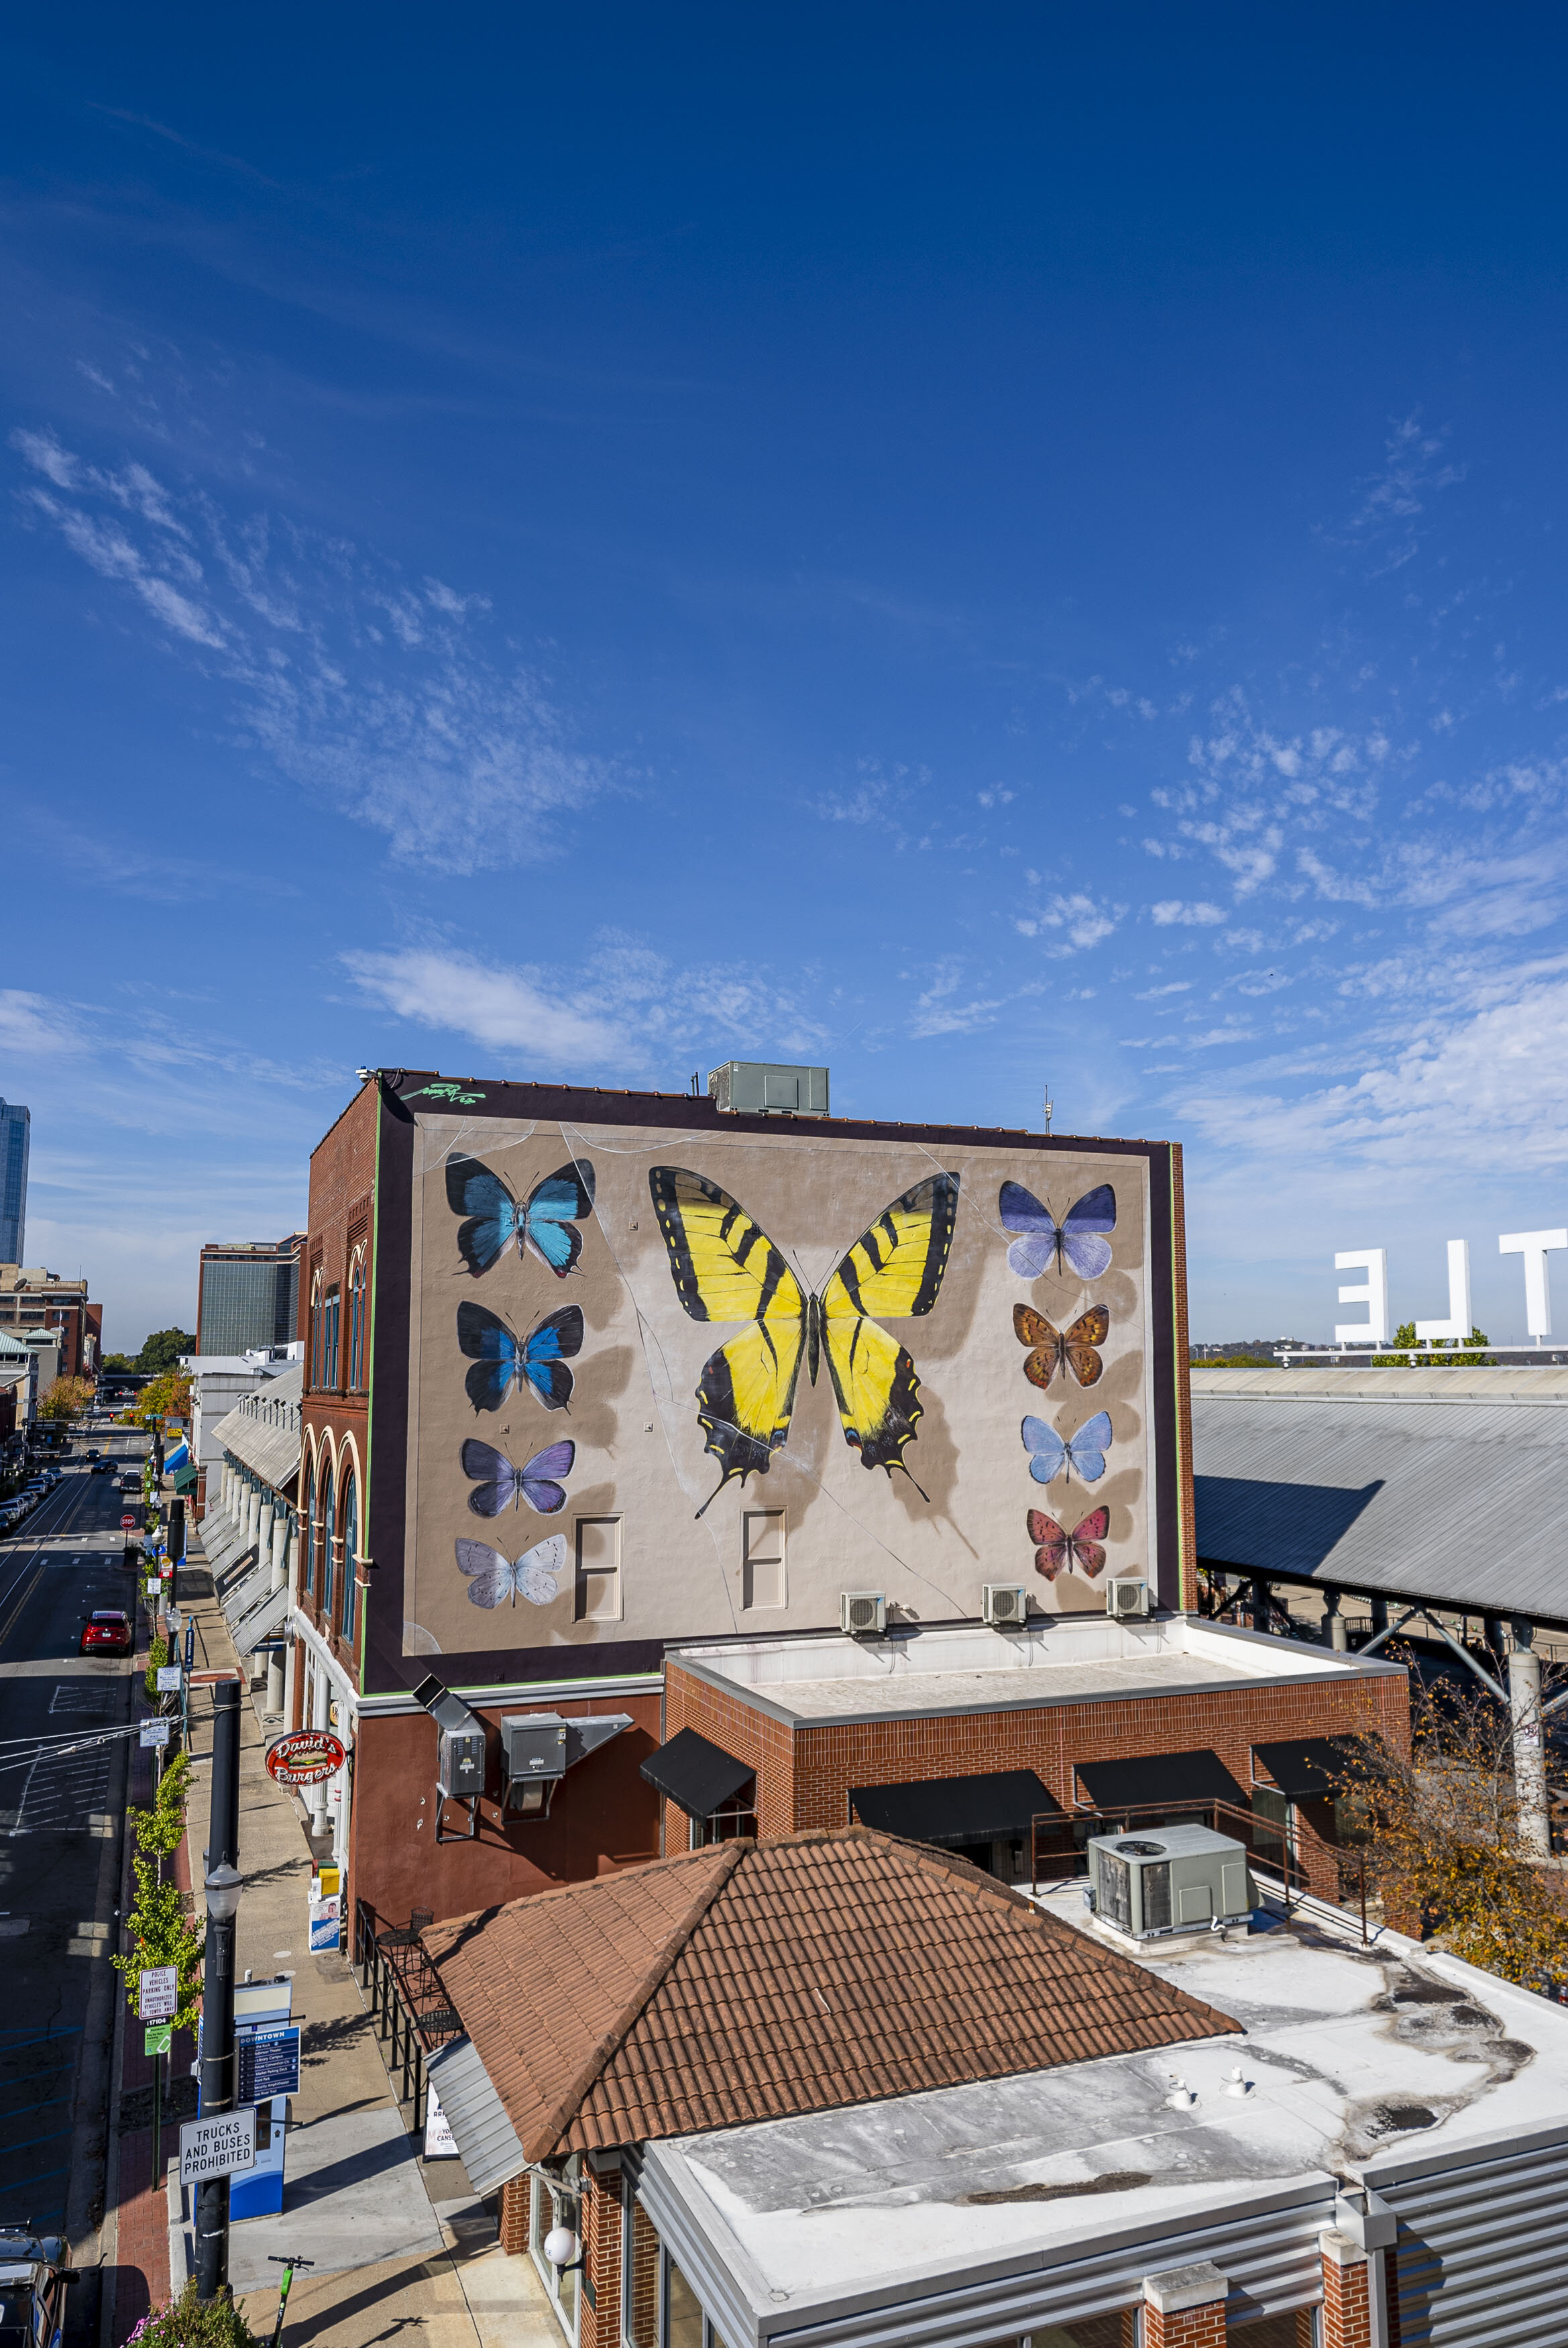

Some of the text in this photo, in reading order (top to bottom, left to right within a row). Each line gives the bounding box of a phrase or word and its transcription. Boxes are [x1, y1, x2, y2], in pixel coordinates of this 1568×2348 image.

[275, 1736, 337, 1759] David's
[274, 1762, 337, 1783] Burgers
[149, 1978, 169, 1986] VEHICLES
[152, 1970, 166, 1978] POLICE
[142, 1986, 161, 1995] PARKING
[145, 1994, 172, 2003] UNAUTHORIZED
[240, 2031, 285, 2043] DOWNTOWN
[197, 2122, 240, 2143] TRUCKS
[185, 2134, 250, 2160] AND BUSES
[184, 2148, 250, 2175] PROHIBITED
